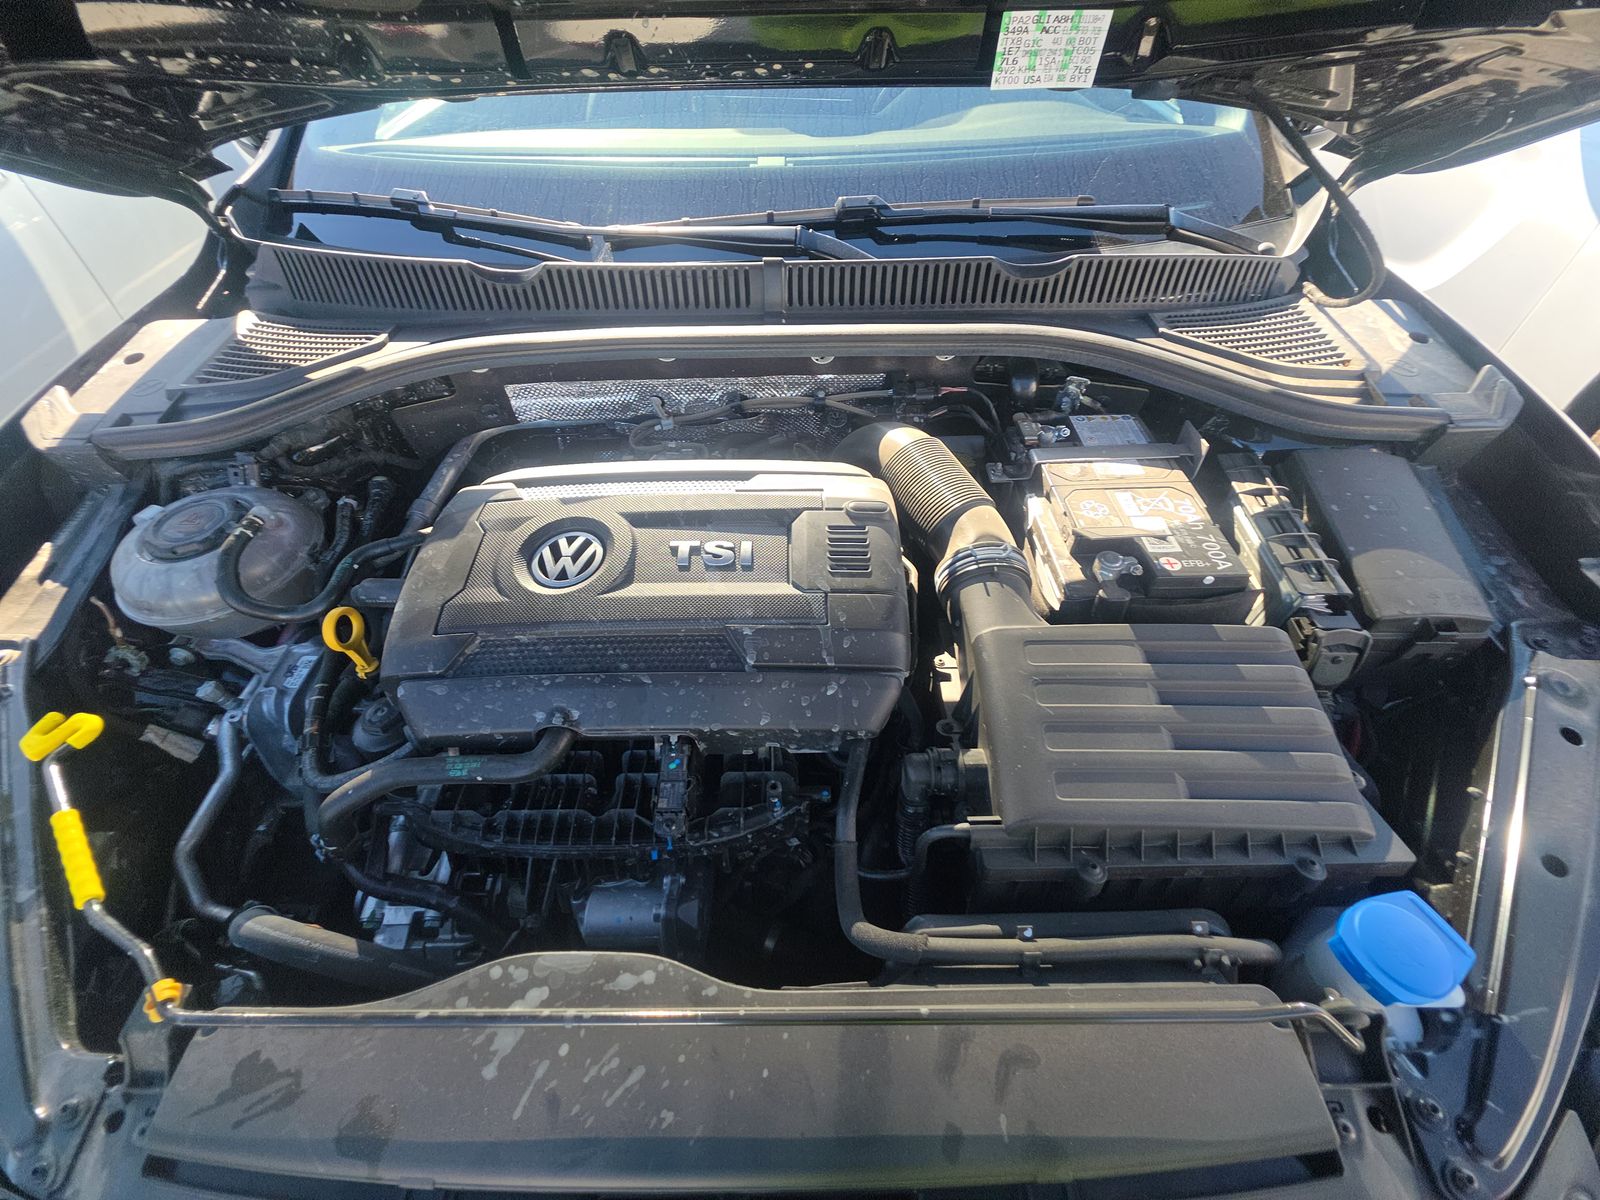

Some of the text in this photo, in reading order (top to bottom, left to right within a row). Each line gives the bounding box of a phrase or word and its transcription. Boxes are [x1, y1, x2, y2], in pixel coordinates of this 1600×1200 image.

[1040, 26, 1060, 34] ACC
[1073, 66, 1092, 74] 7L6
[1023, 76, 1041, 84] USA
[1176, 499, 1205, 530] 70Ah
[1197, 534, 1233, 570] 700A
[670, 541, 754, 566] TSI
